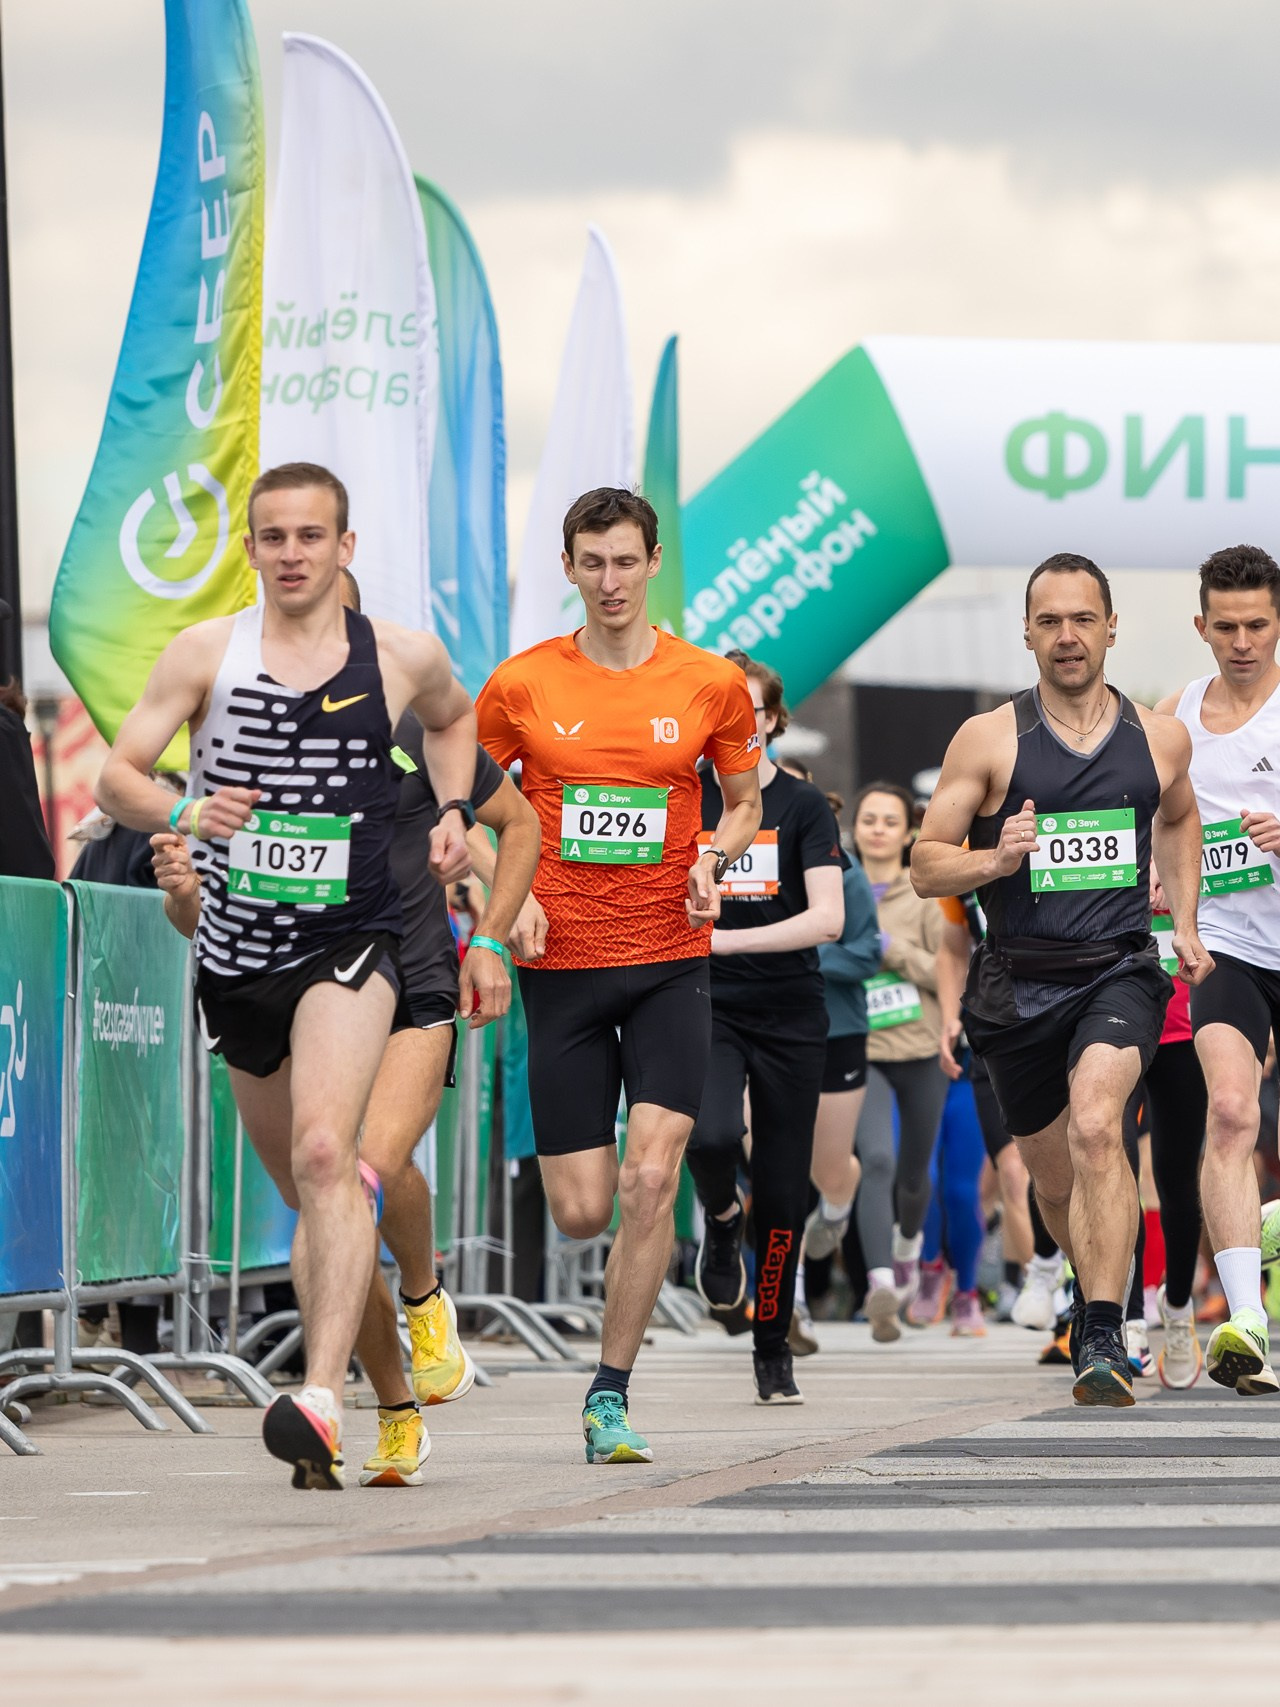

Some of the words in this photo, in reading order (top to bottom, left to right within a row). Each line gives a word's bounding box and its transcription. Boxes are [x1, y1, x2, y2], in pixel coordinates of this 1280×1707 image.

[185, 110, 231, 430] СБЕР
[609, 793, 632, 804] Звук
[579, 810, 647, 838] 0296
[1078, 819, 1100, 829] Звук
[1211, 829, 1229, 839] Звук
[251, 839, 328, 873] 1037
[568, 840, 582, 858] A
[1049, 835, 1119, 864] 0338
[1202, 841, 1249, 871] 1079
[1040, 870, 1056, 888] A
[758, 1229, 793, 1321] Kappa
